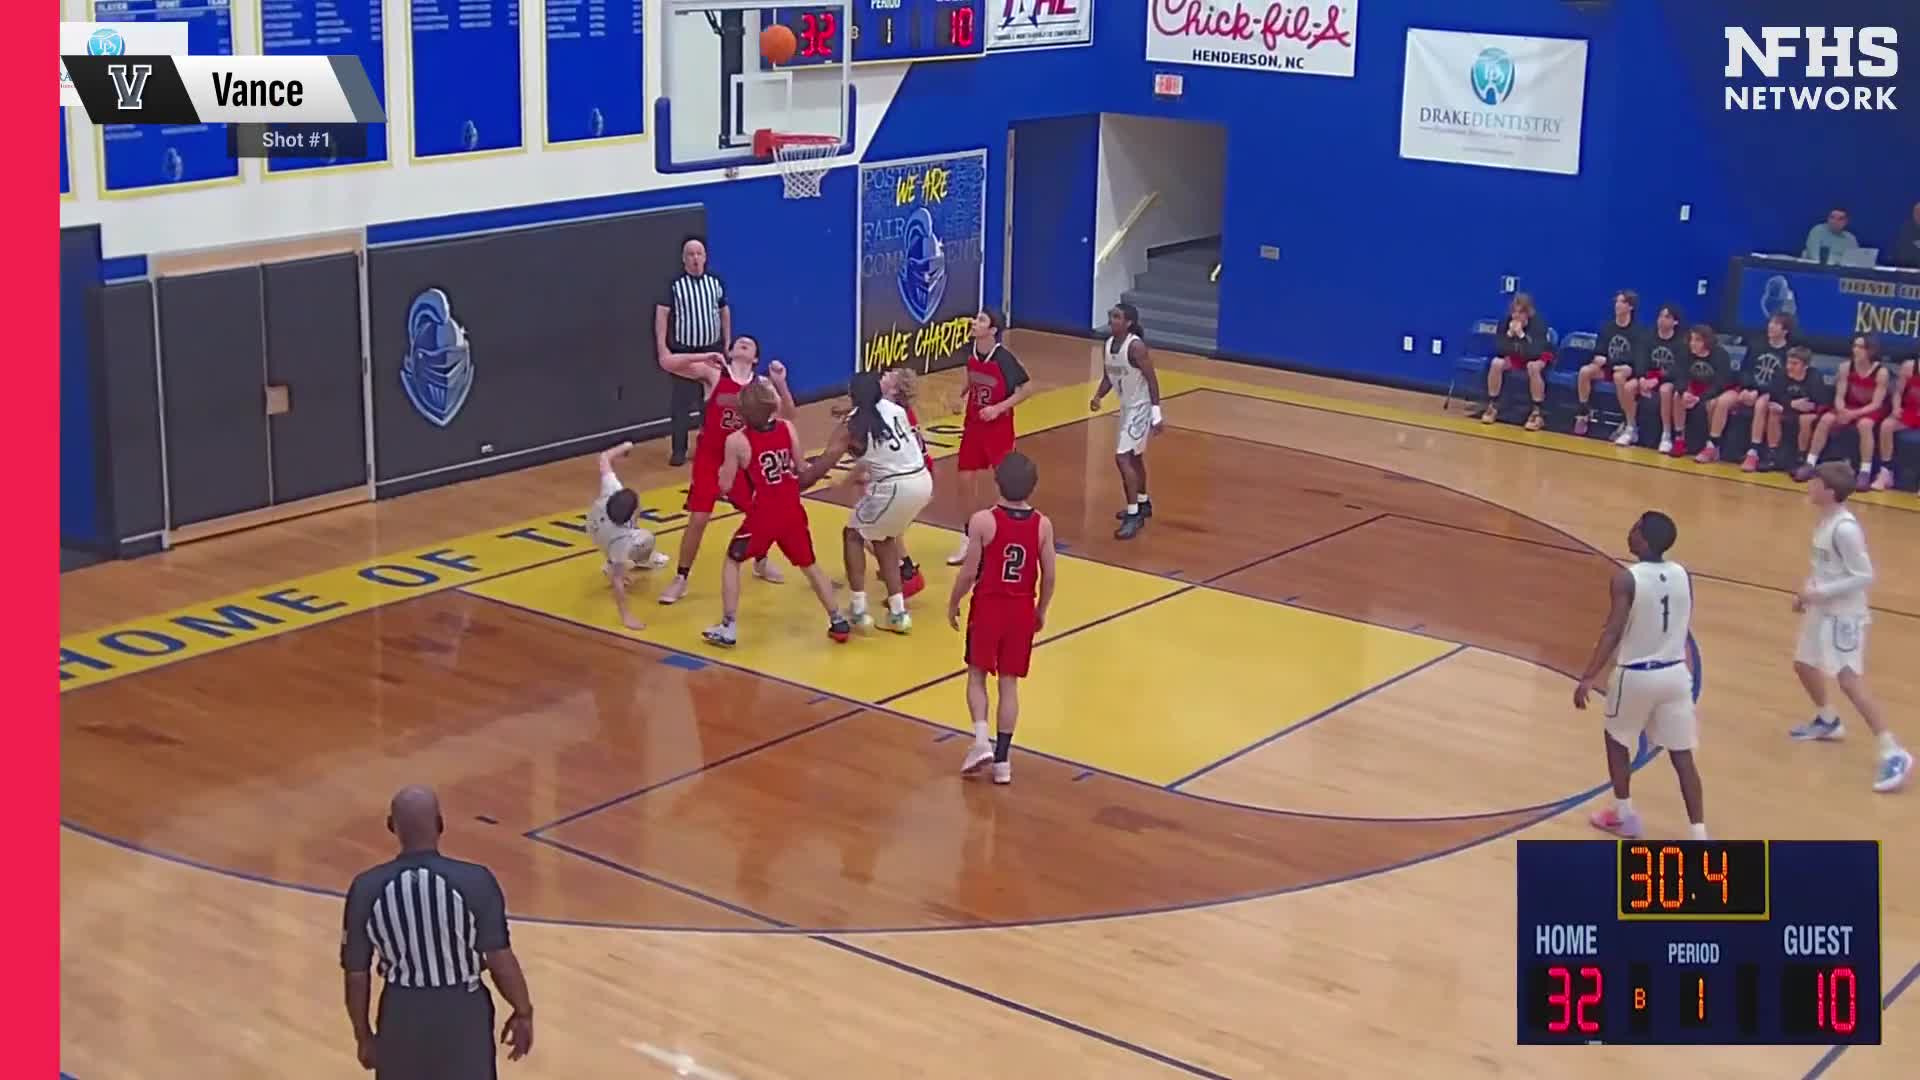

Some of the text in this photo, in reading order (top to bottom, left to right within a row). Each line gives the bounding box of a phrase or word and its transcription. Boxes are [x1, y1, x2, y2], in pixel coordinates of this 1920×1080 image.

[801, 13, 835, 57] 32
[951, 7, 973, 47] 10
[1192, 49, 1304, 69] HENDERSON, NC
[896, 175, 919, 206] WE
[922, 167, 951, 206] ARE
[864, 322, 912, 373] VANCE
[358, 548, 483, 589] OF
[1001, 544, 1026, 582] 2
[1660, 595, 1669, 632] 1
[1630, 846, 1729, 909] 30.4
[1536, 924, 1598, 955] HOME
[1668, 943, 1720, 963] PERIOD
[1783, 925, 1854, 955] GUEST
[1548, 968, 1602, 1032] 32
[1698, 978, 1704, 1019] 1
[1817, 968, 1856, 1032] 10
